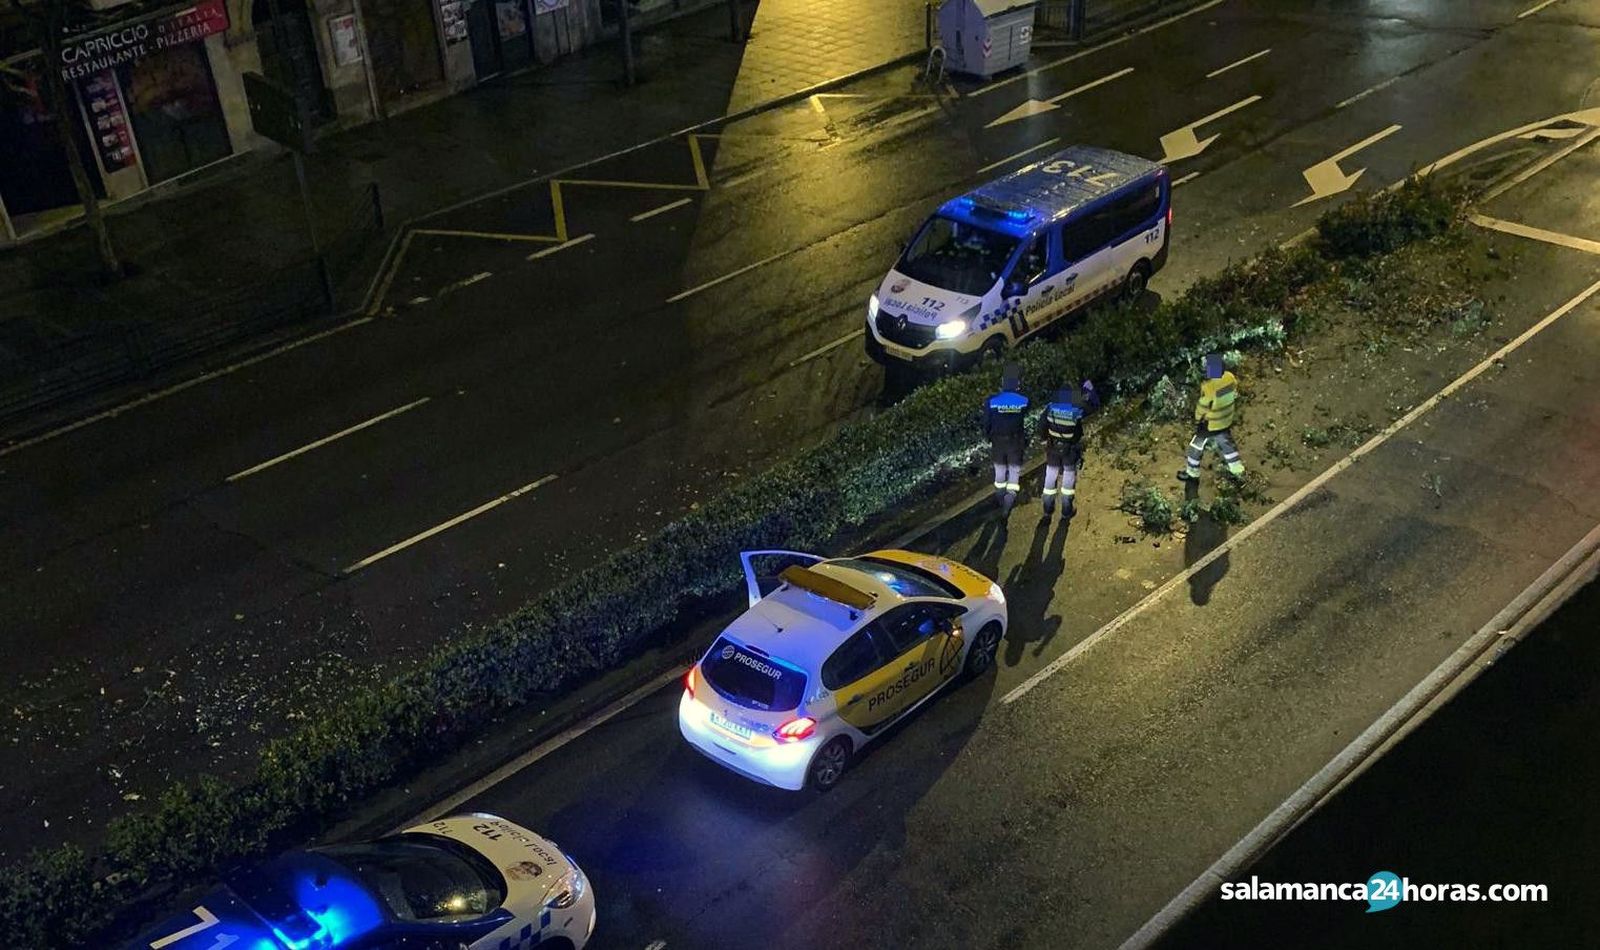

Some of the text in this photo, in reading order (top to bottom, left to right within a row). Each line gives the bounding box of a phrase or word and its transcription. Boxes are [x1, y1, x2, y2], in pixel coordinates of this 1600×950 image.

[61, 24, 149, 63] CAPRICCIO
[61, 44, 147, 81] RESTAURANTE
[156, 22, 211, 49] PIZZERIA
[1144, 229, 1160, 244] 112
[921, 297, 945, 311] 112
[733, 652, 782, 680] PROSEGUR
[867, 657, 936, 712] PROSEGUR
[473, 823, 502, 841] 112
